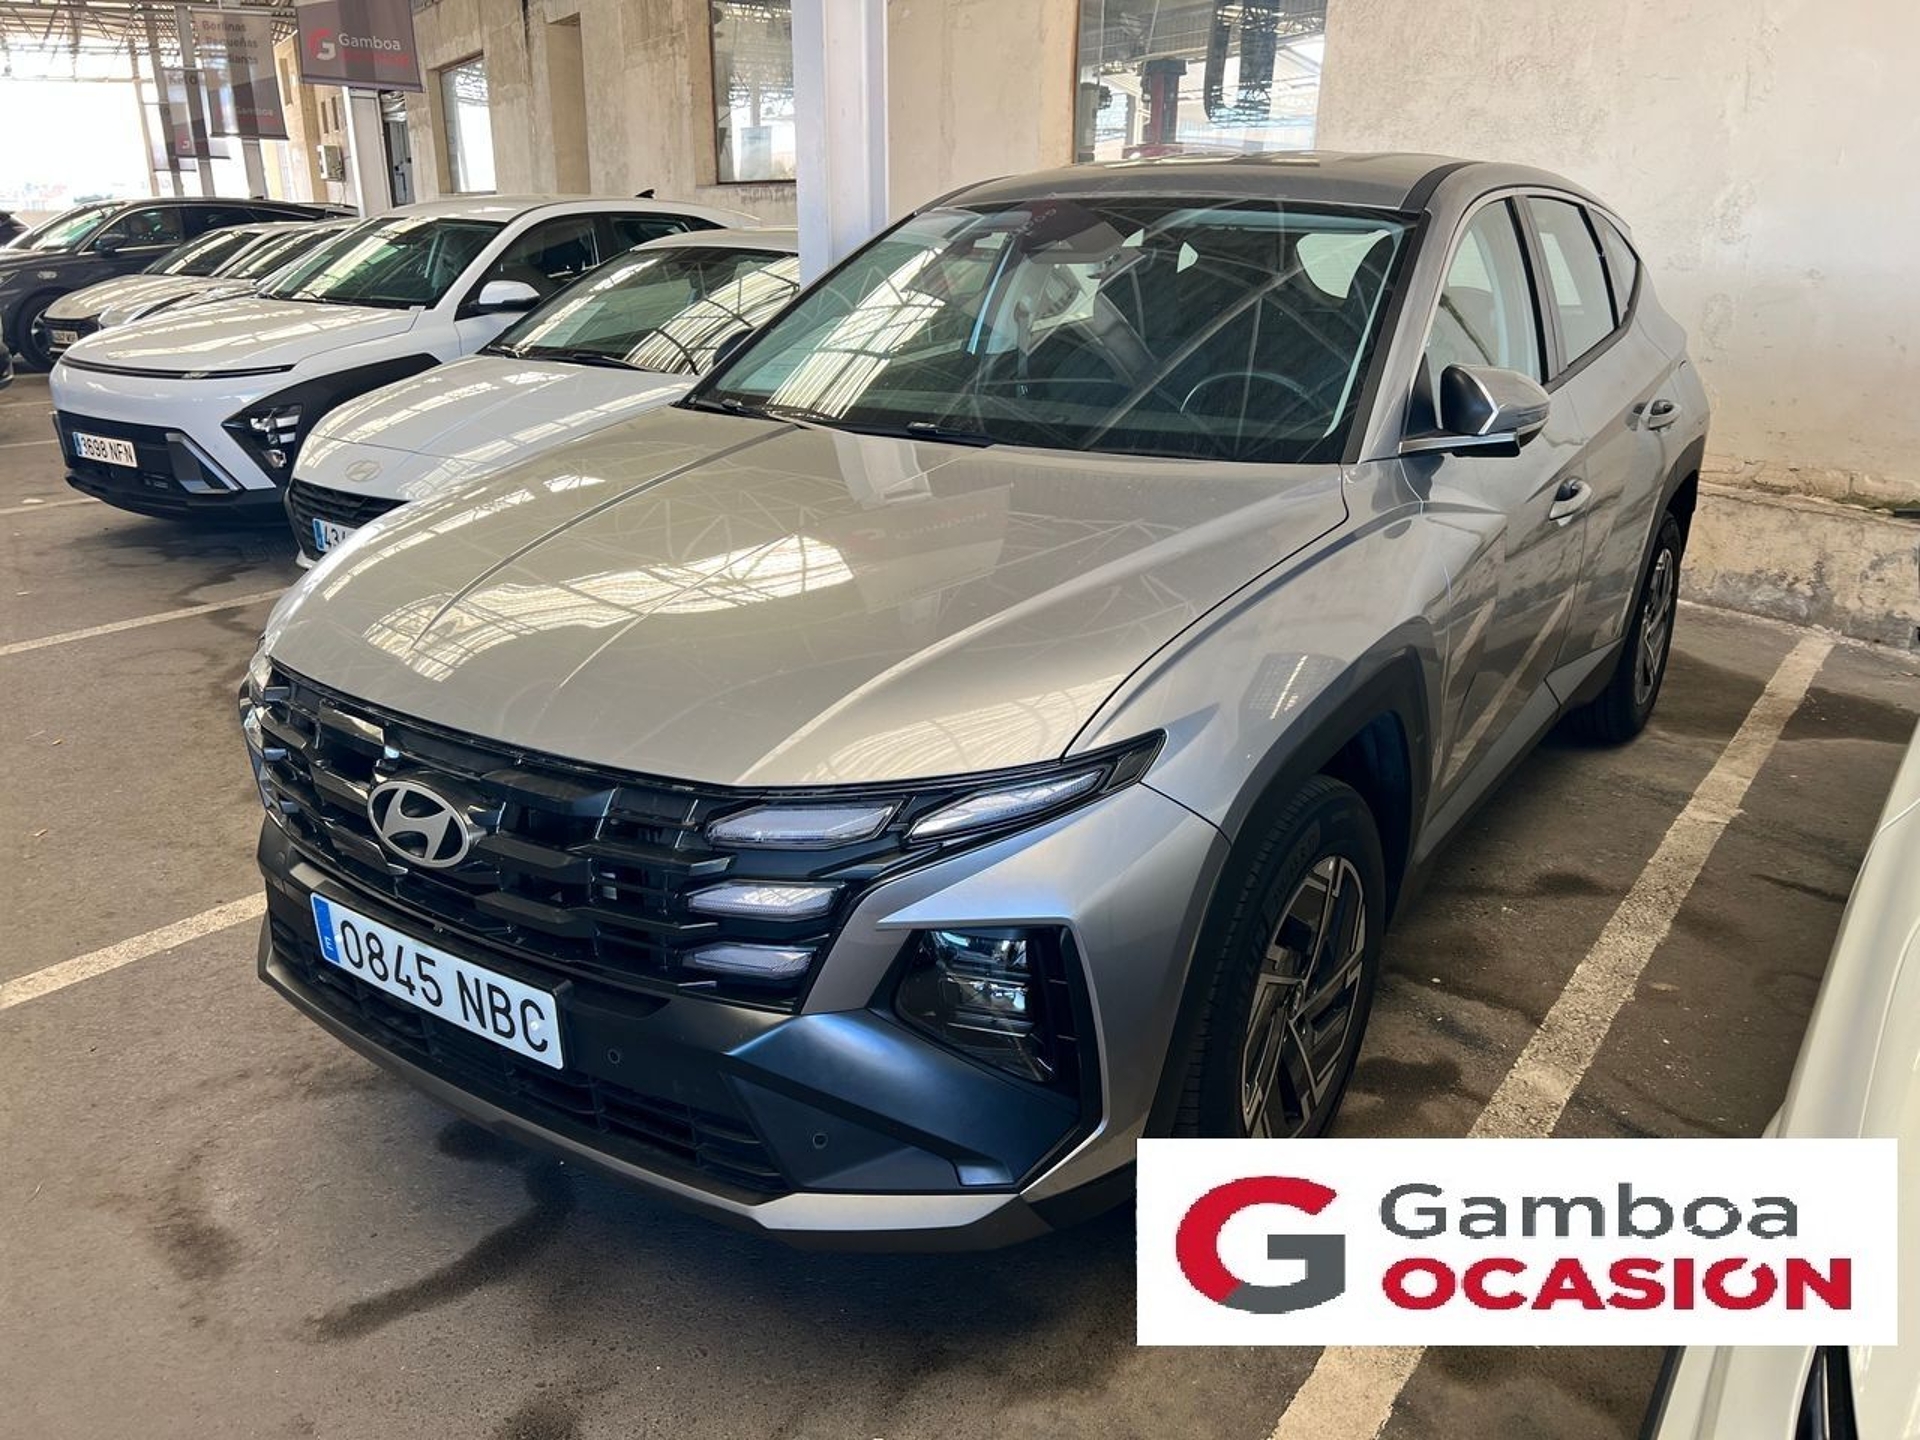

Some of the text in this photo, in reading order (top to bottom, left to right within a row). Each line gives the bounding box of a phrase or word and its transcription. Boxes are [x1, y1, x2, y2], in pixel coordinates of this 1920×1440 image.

[338, 32, 402, 51] Gamboa
[80, 437, 134, 463] 3698 NFN
[340, 919, 549, 1053] 0845 NBC
